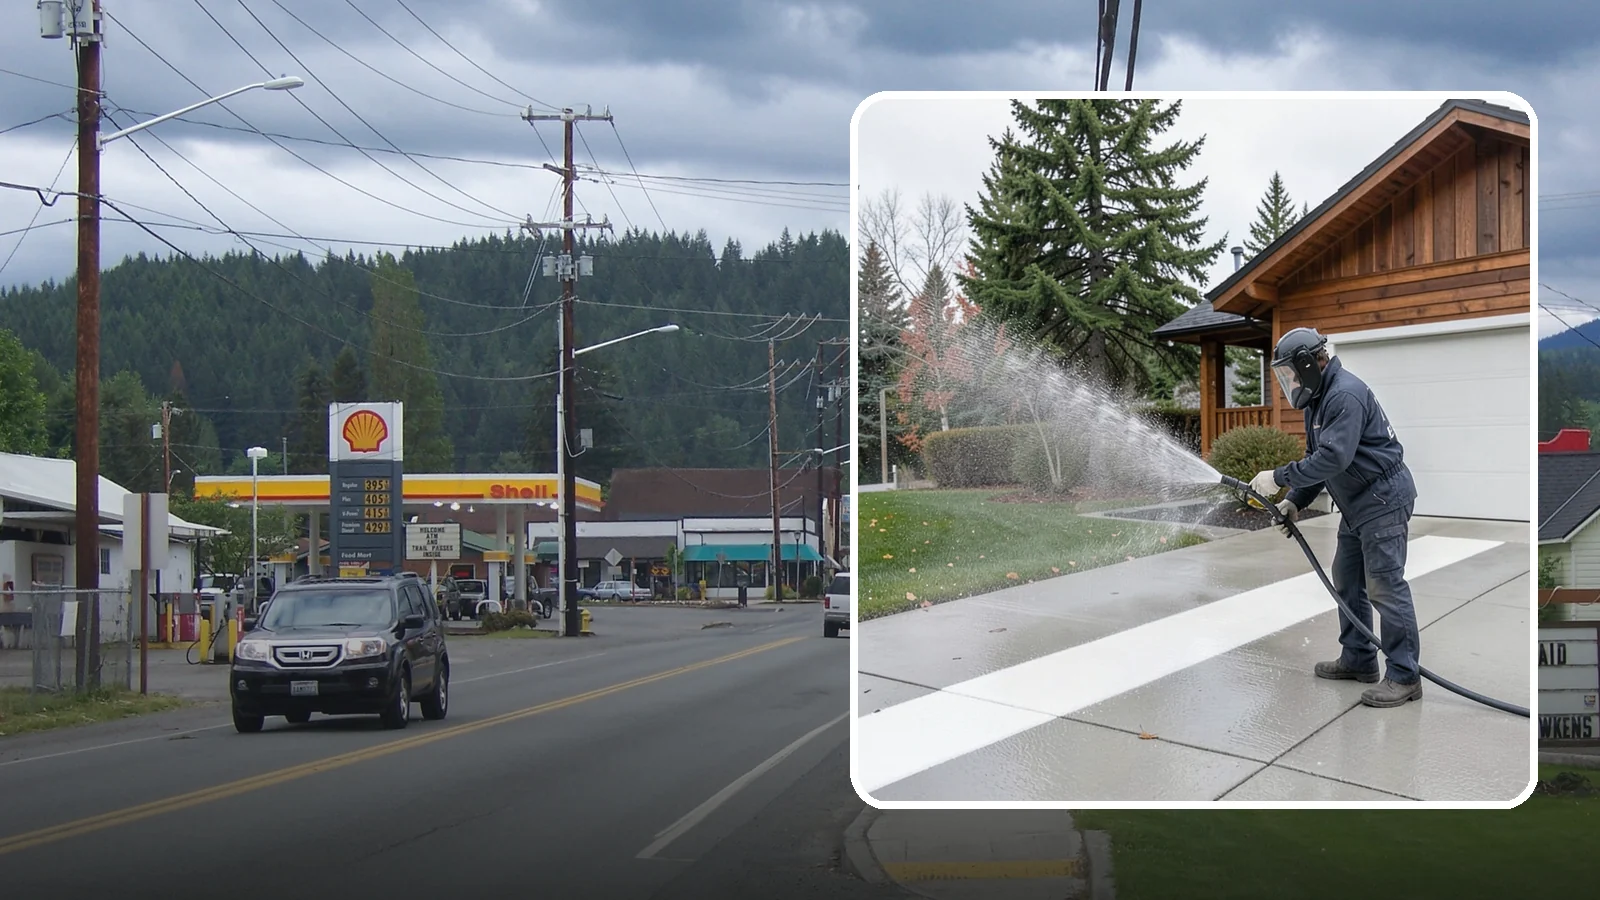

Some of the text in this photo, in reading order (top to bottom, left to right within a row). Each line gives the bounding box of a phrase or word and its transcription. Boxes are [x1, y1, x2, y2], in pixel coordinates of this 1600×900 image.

[366, 480, 383, 490] 395
[490, 484, 547, 499] Shell
[366, 494, 383, 504] 405
[366, 508, 383, 518] 415
[366, 522, 383, 532] 429
